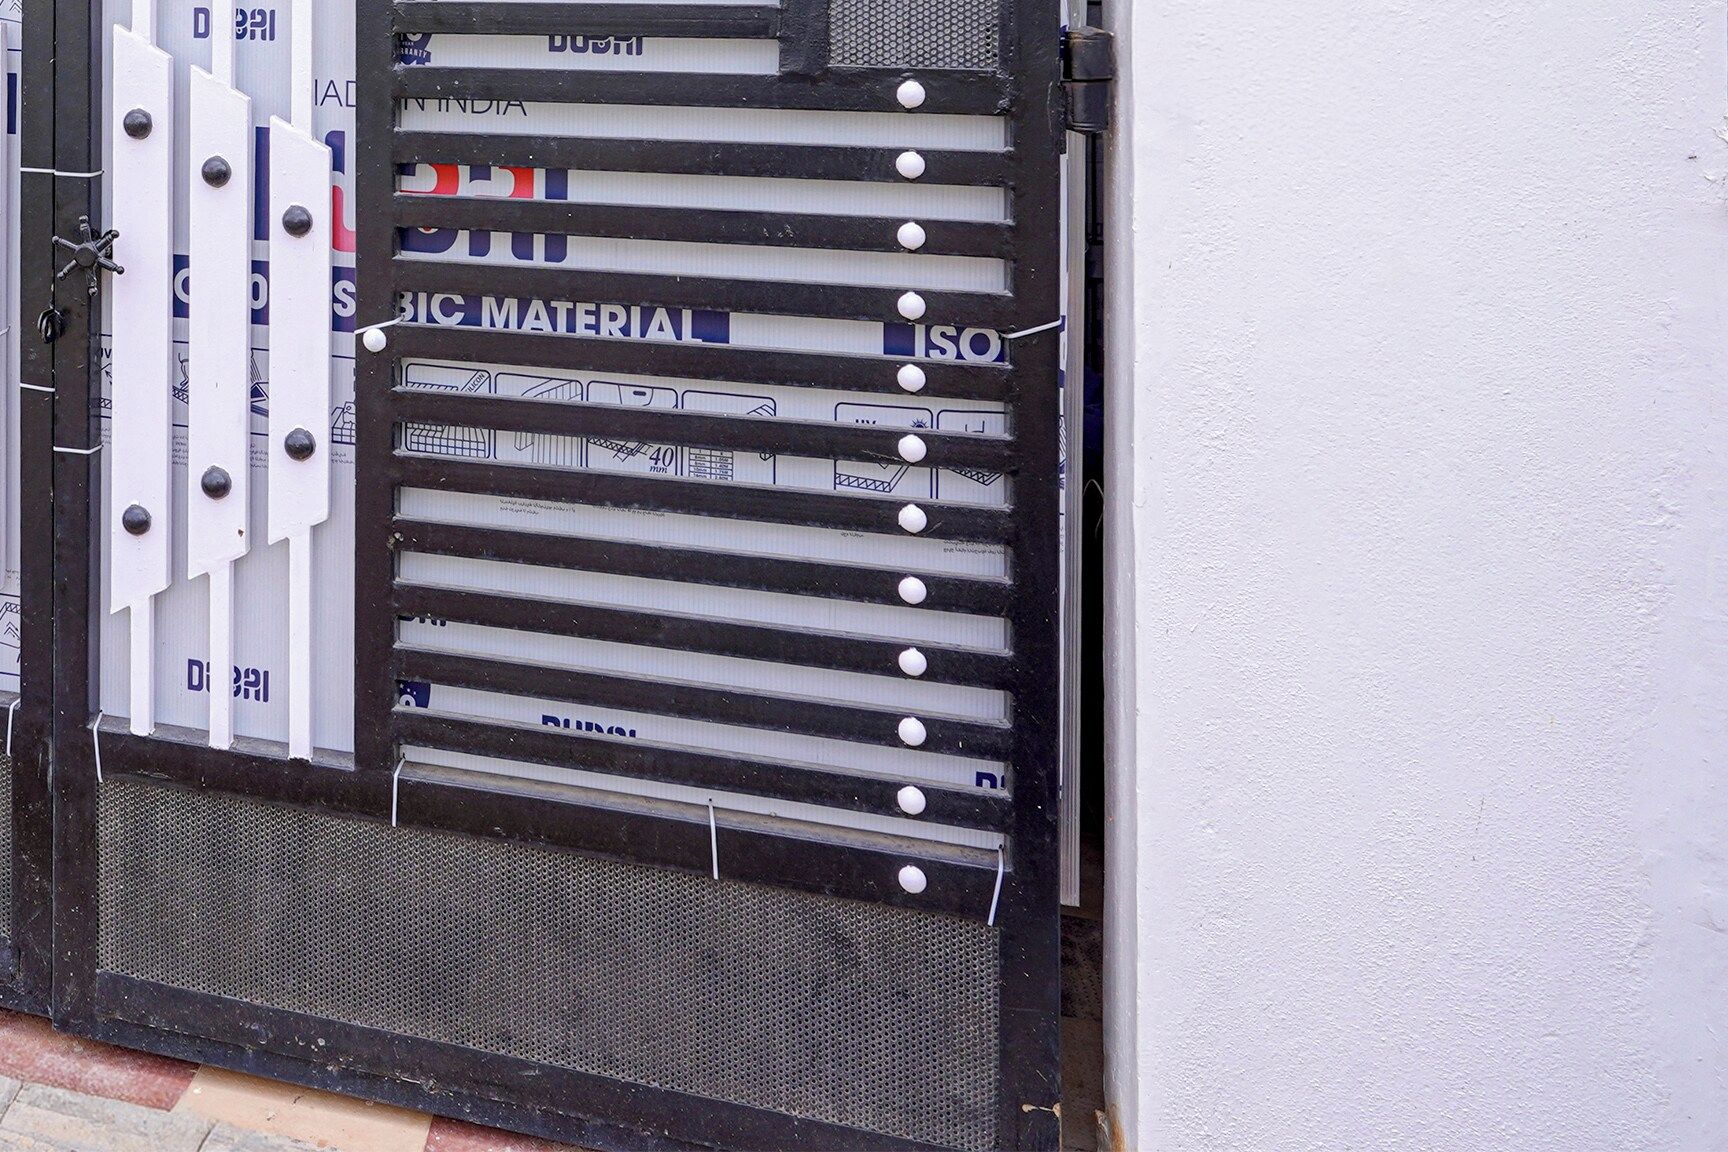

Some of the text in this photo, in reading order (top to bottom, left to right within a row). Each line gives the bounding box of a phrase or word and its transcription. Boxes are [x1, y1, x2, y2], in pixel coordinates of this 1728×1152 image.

[193, 7, 276, 41] DBAI
[481, 295, 703, 343] MATERIAL
[915, 324, 1003, 362] ISO
[648, 446, 674, 467] 40
[649, 465, 668, 474] mm
